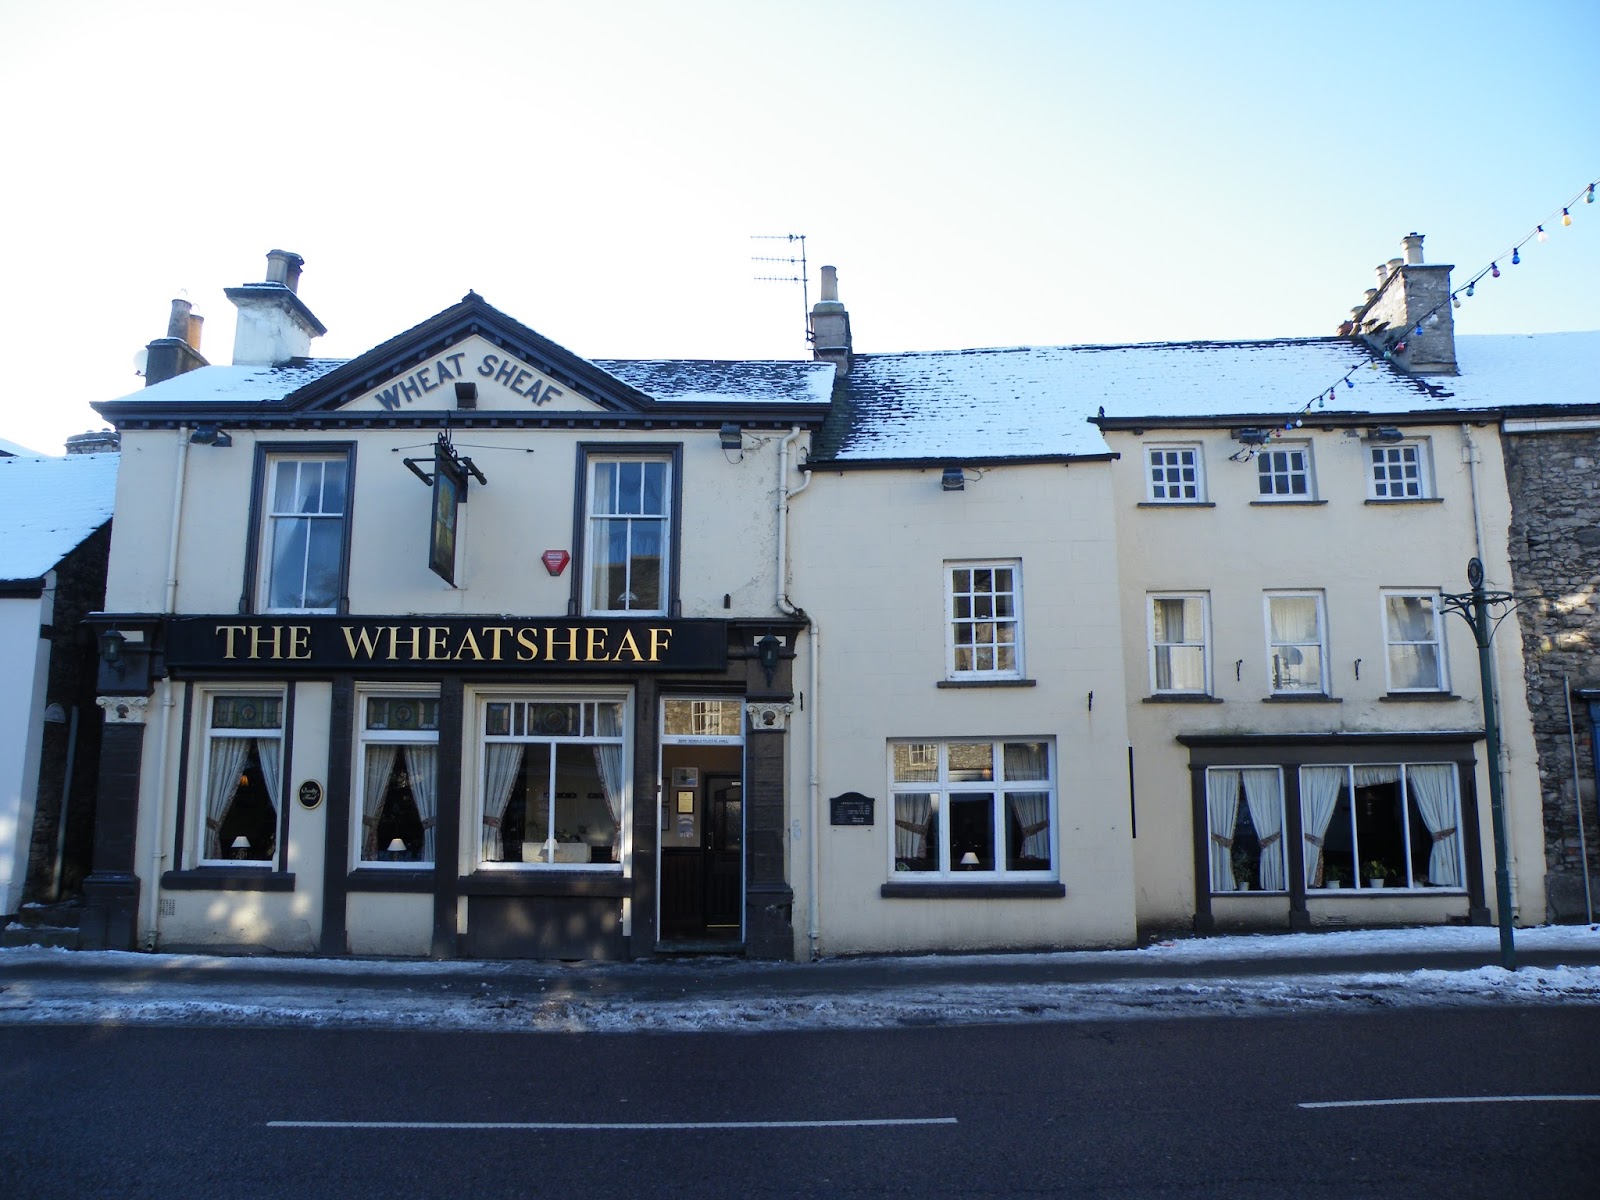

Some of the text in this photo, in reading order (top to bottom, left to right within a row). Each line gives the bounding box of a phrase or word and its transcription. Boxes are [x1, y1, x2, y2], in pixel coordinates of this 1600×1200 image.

[375, 352, 563, 411] WHEAT SHEAF
[215, 626, 673, 661] THE WHEATSHEAF
